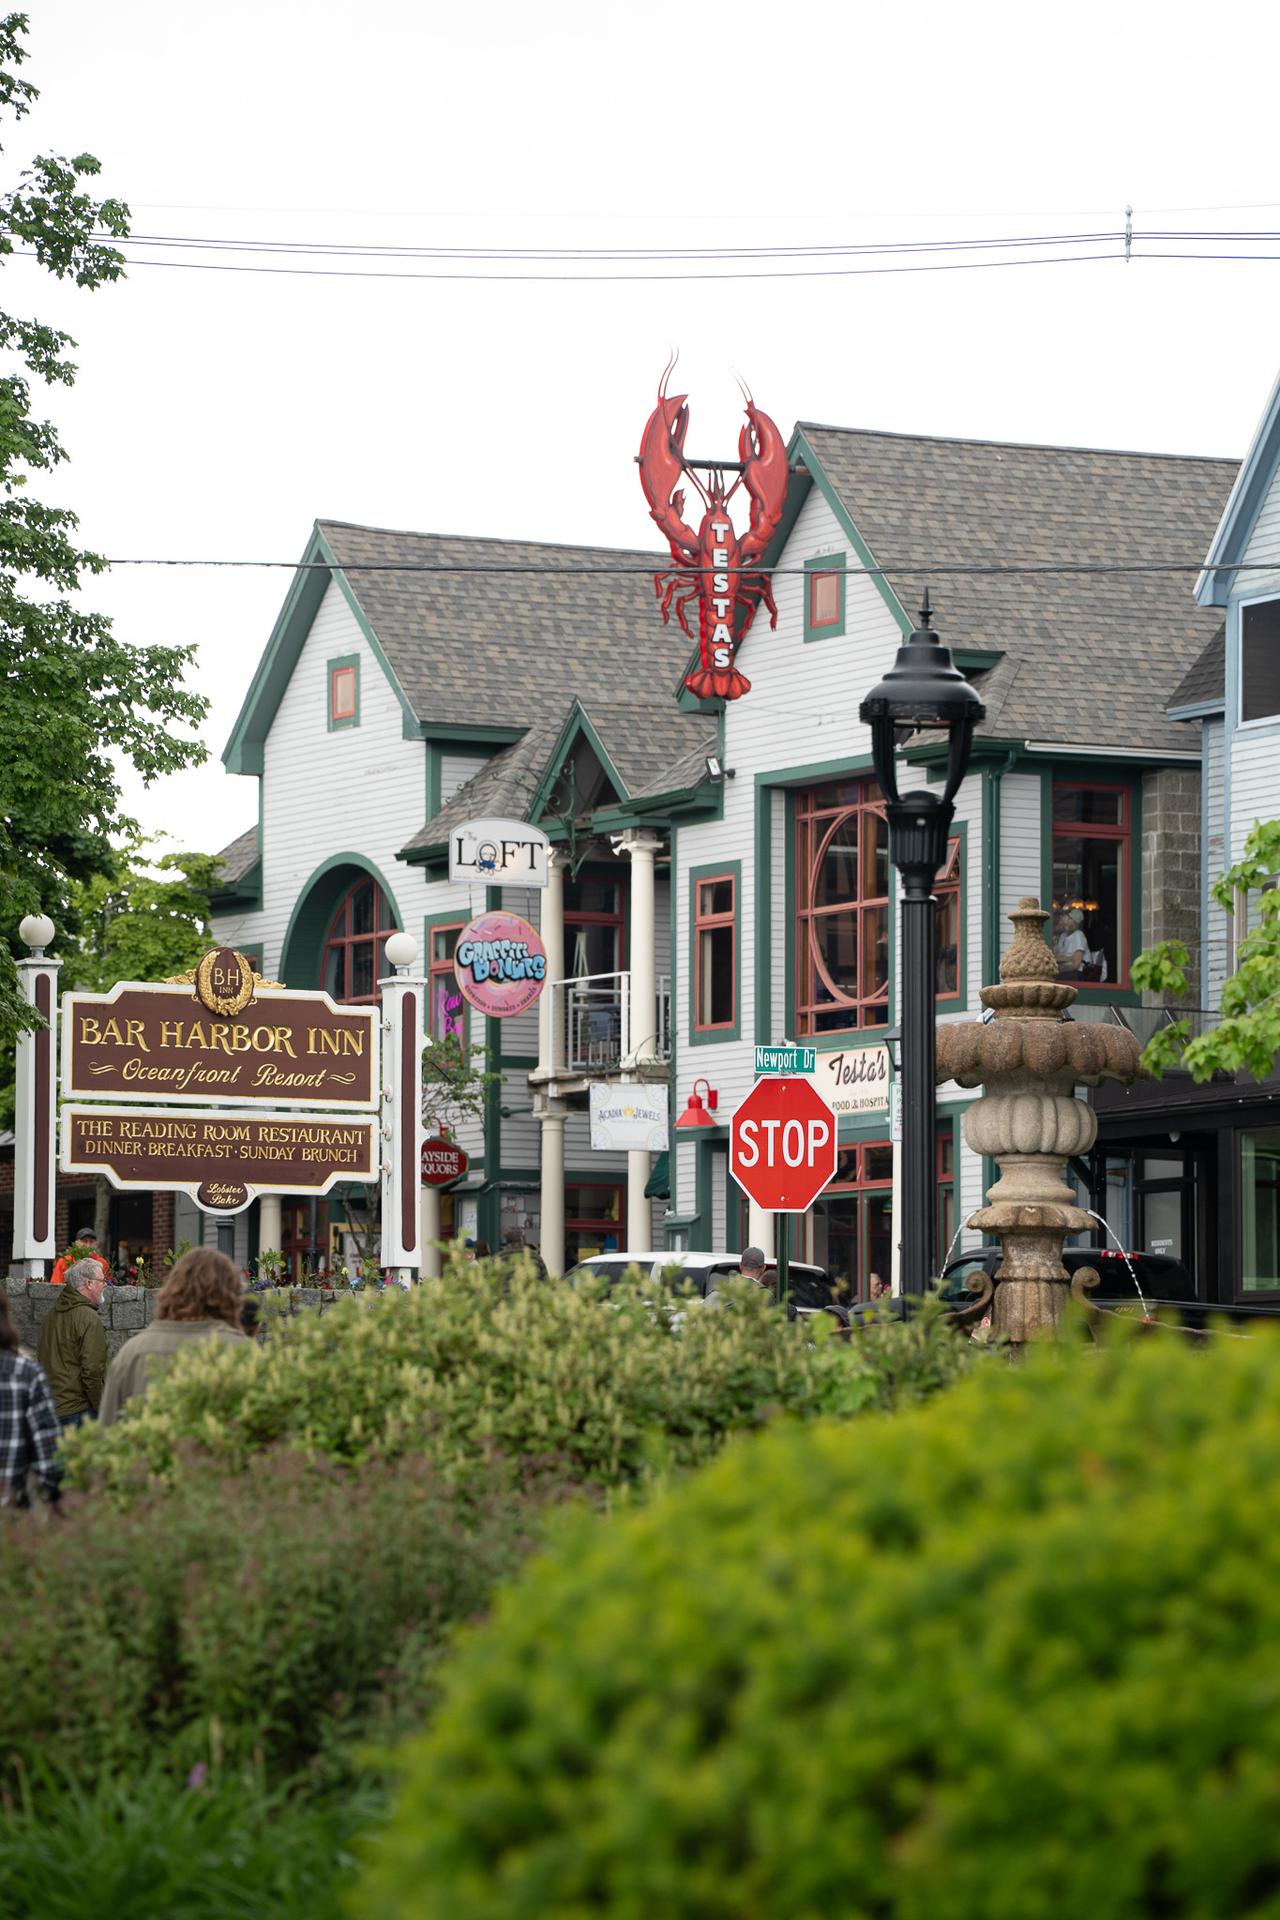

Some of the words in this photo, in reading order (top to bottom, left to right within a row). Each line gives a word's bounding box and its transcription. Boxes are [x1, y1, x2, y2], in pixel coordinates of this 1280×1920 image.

[456, 837, 544, 870] LOFT
[214, 967, 239, 986] BH
[219, 986, 234, 994] INN
[80, 1016, 150, 1053] BAR
[160, 1020, 297, 1058] HARBOR
[307, 1027, 364, 1057] INN
[756, 1048, 797, 1070] Newport
[803, 1050, 815, 1069] Dr
[829, 1050, 887, 1086] Testa's
[122, 1057, 242, 1091] Oceanfront
[251, 1062, 327, 1088] Resort
[860, 1096, 889, 1110] HOSPITA
[77, 1120, 113, 1137] THE
[119, 1122, 196, 1140] READING
[204, 1125, 250, 1142] ROOM
[258, 1127, 366, 1146] RESTAURANT
[737, 1119, 830, 1168] STOP
[85, 1140, 143, 1156] DINNER
[147, 1142, 232, 1159] BREAKFAST
[239, 1145, 296, 1161] SUNDAY
[302, 1147, 357, 1163] BRUNCH
[421, 1151, 459, 1163] AYSIDE
[421, 1163, 459, 1175] IQUORS
[207, 1183, 244, 1194] Lobster
[210, 1194, 239, 1205] Bake
